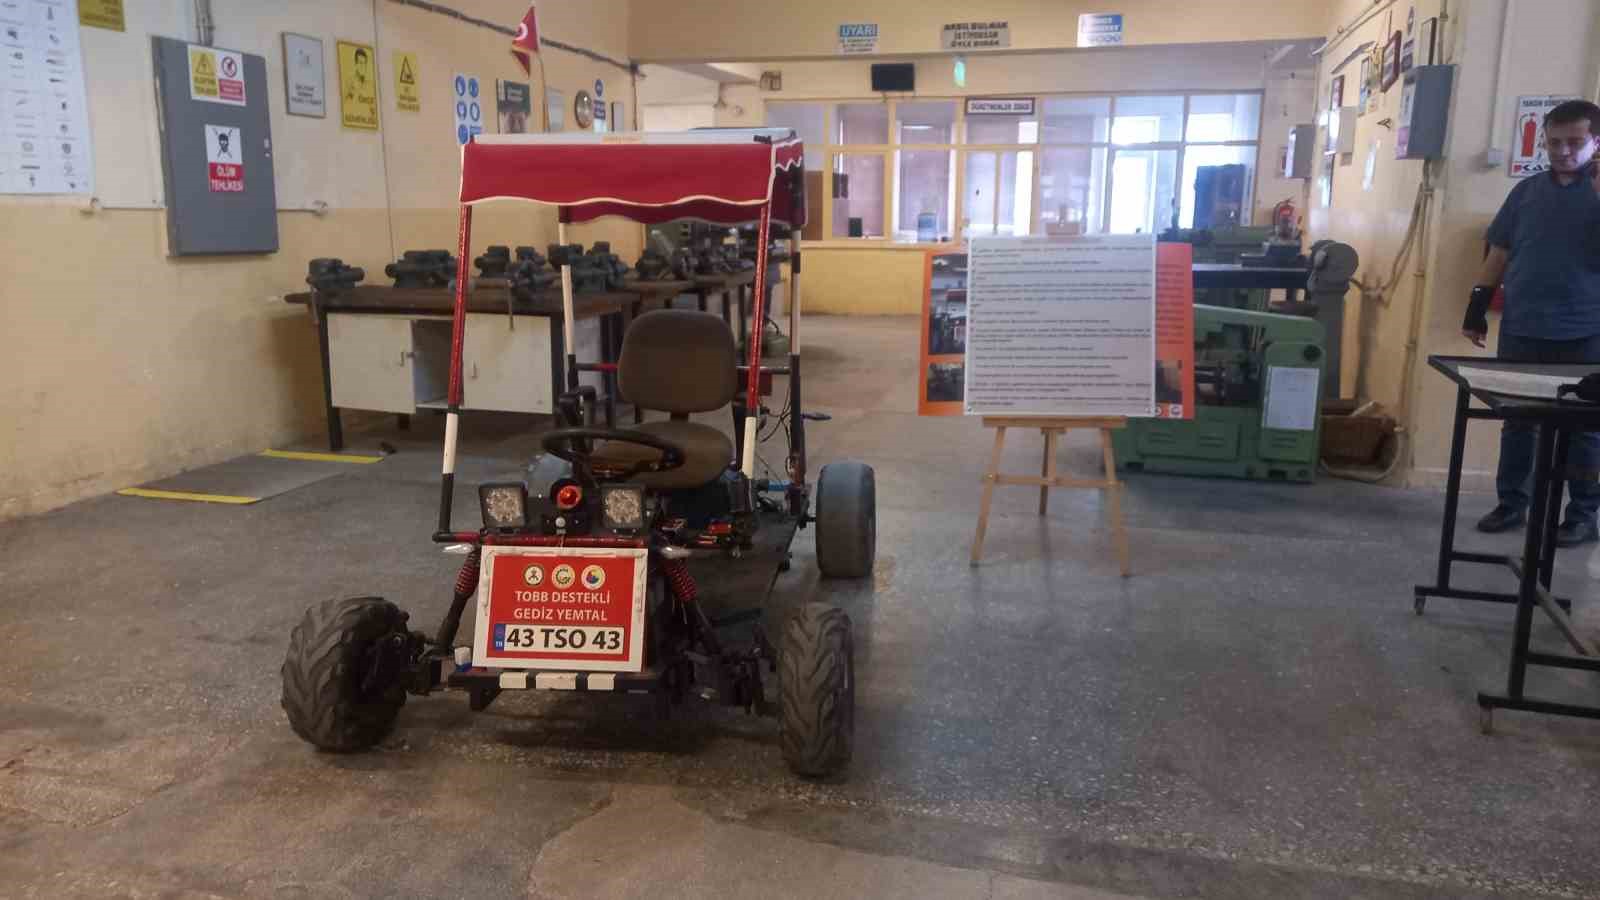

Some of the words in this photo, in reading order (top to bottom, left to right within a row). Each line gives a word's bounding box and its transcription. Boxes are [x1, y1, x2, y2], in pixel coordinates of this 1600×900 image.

[514, 591, 549, 603] TOBB
[552, 590, 611, 604] DESTEKLİ
[513, 606, 553, 620] GEDİZ
[556, 608, 608, 621] YEMTAL
[507, 628, 535, 648] 43
[540, 628, 587, 649] TSO
[592, 630, 620, 650] 43
